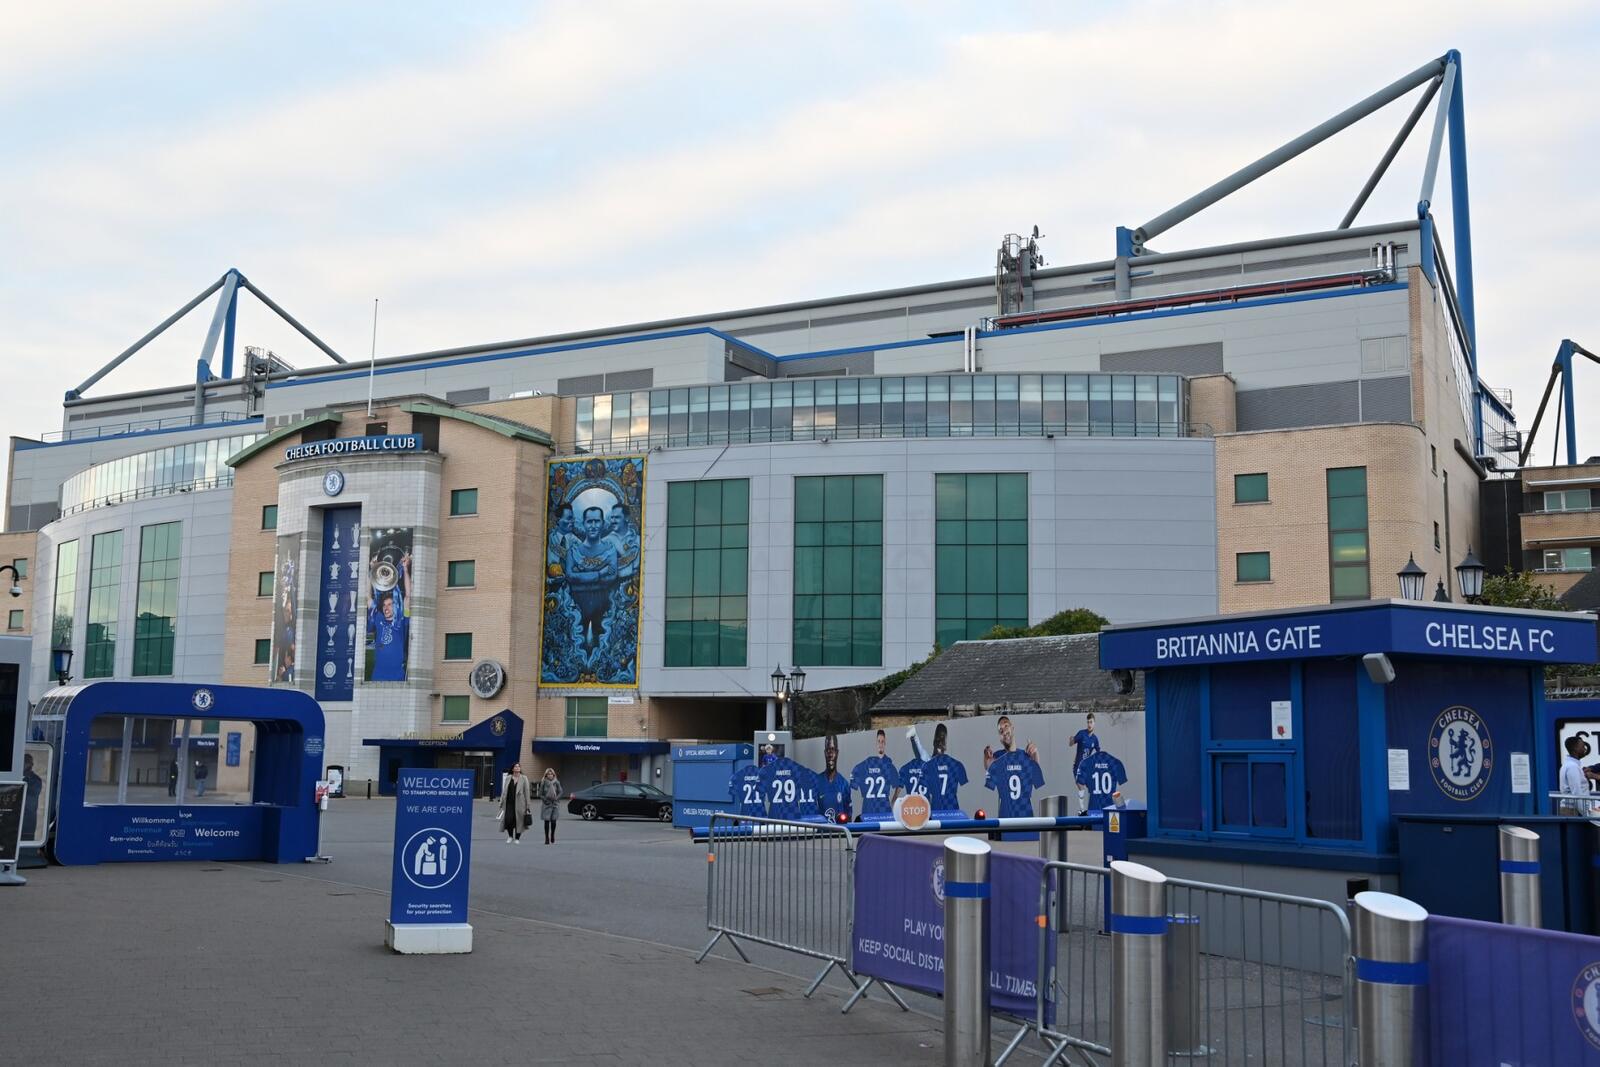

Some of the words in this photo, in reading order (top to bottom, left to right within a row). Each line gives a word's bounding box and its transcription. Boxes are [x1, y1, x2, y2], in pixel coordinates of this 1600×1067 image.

[285, 445, 320, 460] CHELSEA
[322, 439, 380, 454] FOOTBALL
[382, 437, 416, 449] CLUB
[1156, 631, 1260, 660] BRITANNIA
[1266, 626, 1322, 652] GATE
[1425, 622, 1523, 652] CHELSEA
[1528, 629, 1555, 654] FC
[1438, 709, 1480, 730] CHELSEA
[404, 776, 470, 789] WELCOME
[772, 779, 796, 804] 29
[865, 776, 886, 798] 22
[938, 774, 948, 796] 7
[1008, 774, 1021, 800] 9
[1092, 772, 1112, 794] 10
[1440, 778, 1468, 796] FOOTBALL
[1470, 778, 1484, 793] CLUB
[743, 784, 762, 804] 21
[800, 788, 814, 802] 11
[406, 805, 420, 813] WE
[422, 806, 438, 814] ARE
[440, 806, 463, 814] OPEN
[904, 806, 926, 816] STOP
[194, 828, 240, 837] Welcome
[904, 918, 927, 936] PLAY
[928, 923, 944, 940] YO
[858, 938, 881, 955] KEEP
[882, 943, 916, 966] SOCIAL
[918, 952, 944, 972] DISTA
[990, 970, 1002, 989] LL
[1005, 974, 1037, 998] TIMES
